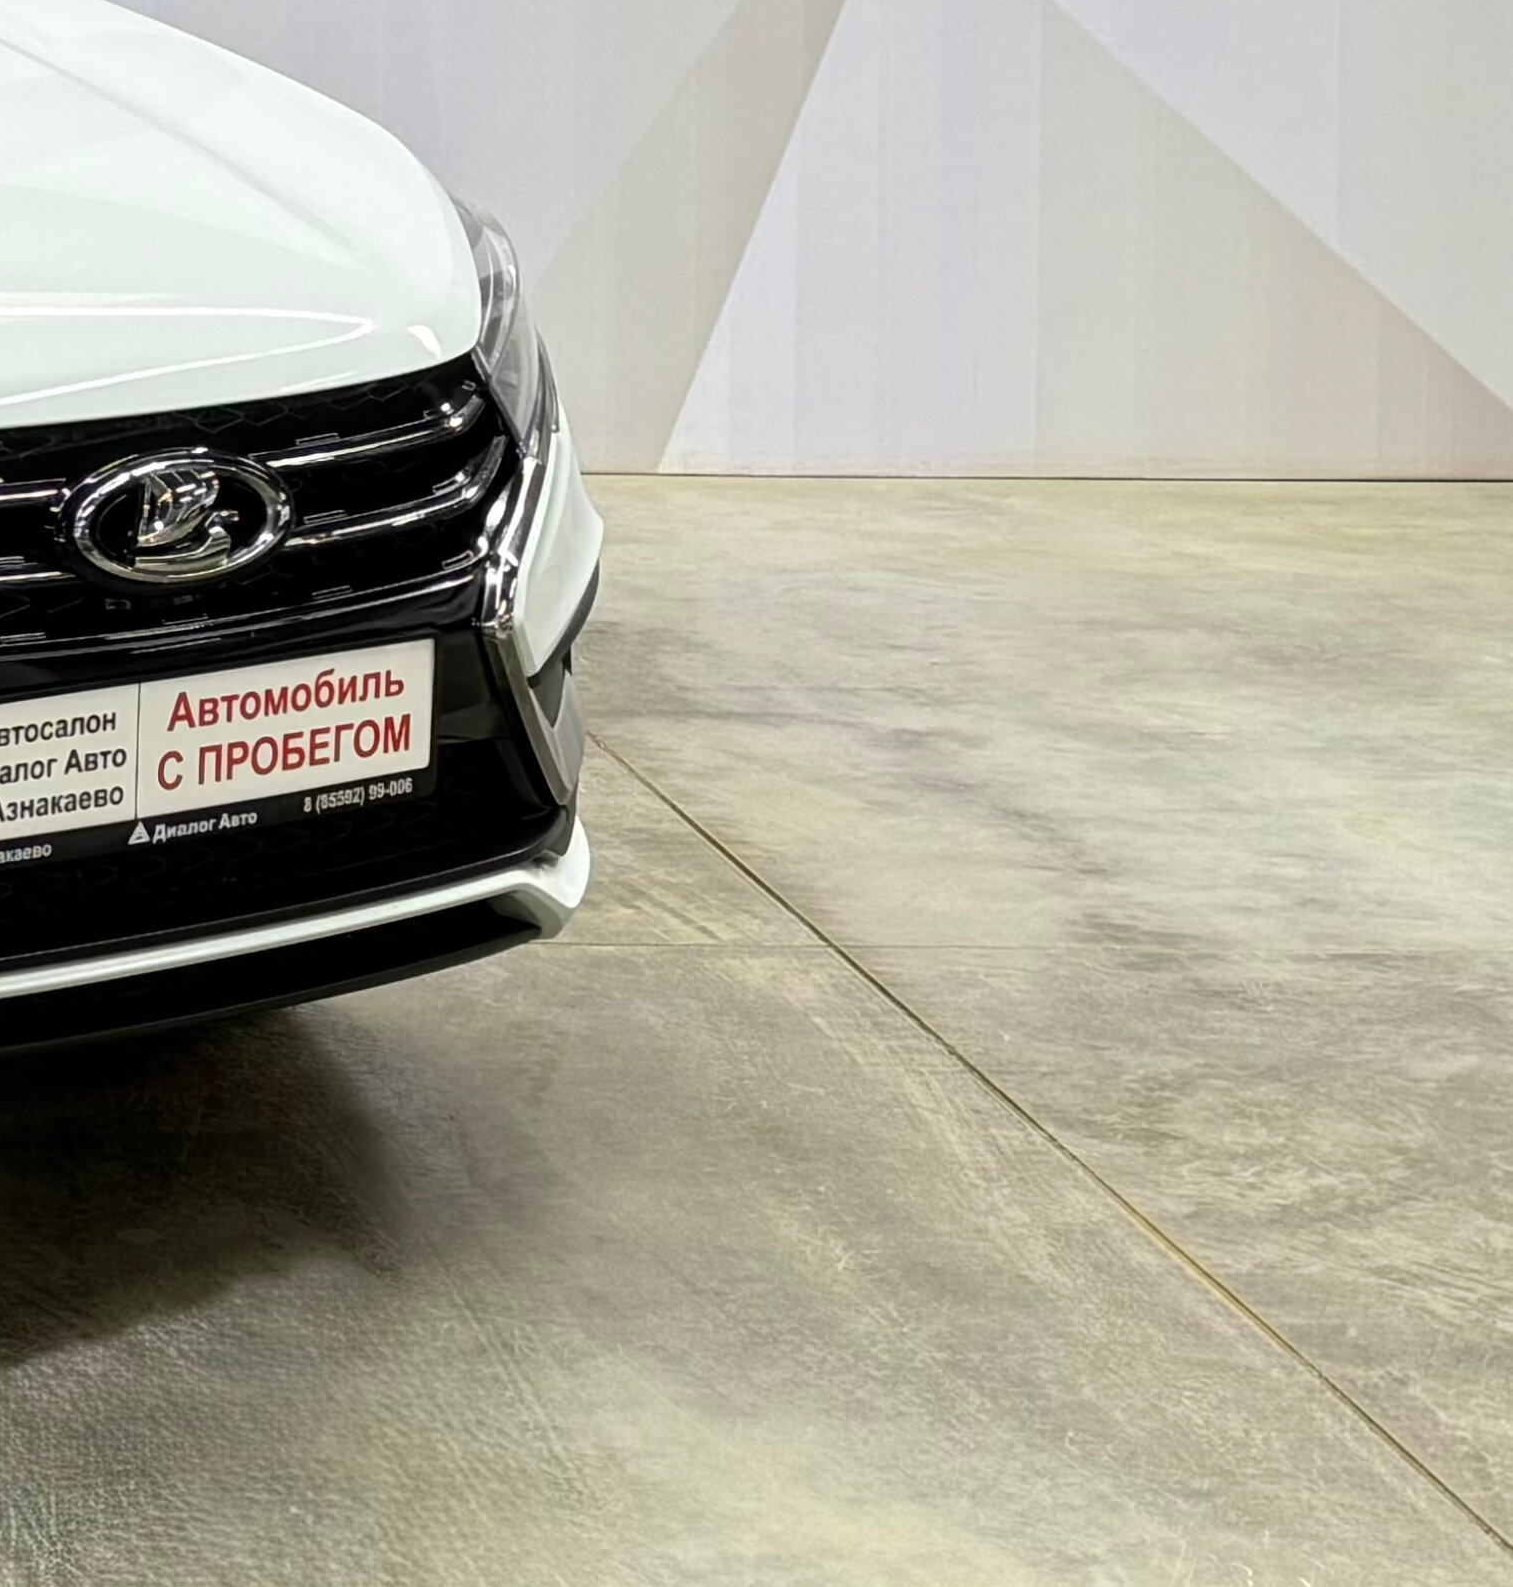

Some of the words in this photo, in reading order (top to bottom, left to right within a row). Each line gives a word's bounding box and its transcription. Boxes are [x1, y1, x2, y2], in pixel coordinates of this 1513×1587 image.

[167, 668, 404, 732] Автомобиль
[64, 748, 128, 774] Авто
[157, 750, 184, 791] С
[198, 713, 411, 785] ПРОБЕГОМ
[303, 796, 313, 813] 8
[152, 819, 216, 844] Диалог
[218, 812, 258, 829] Авто
